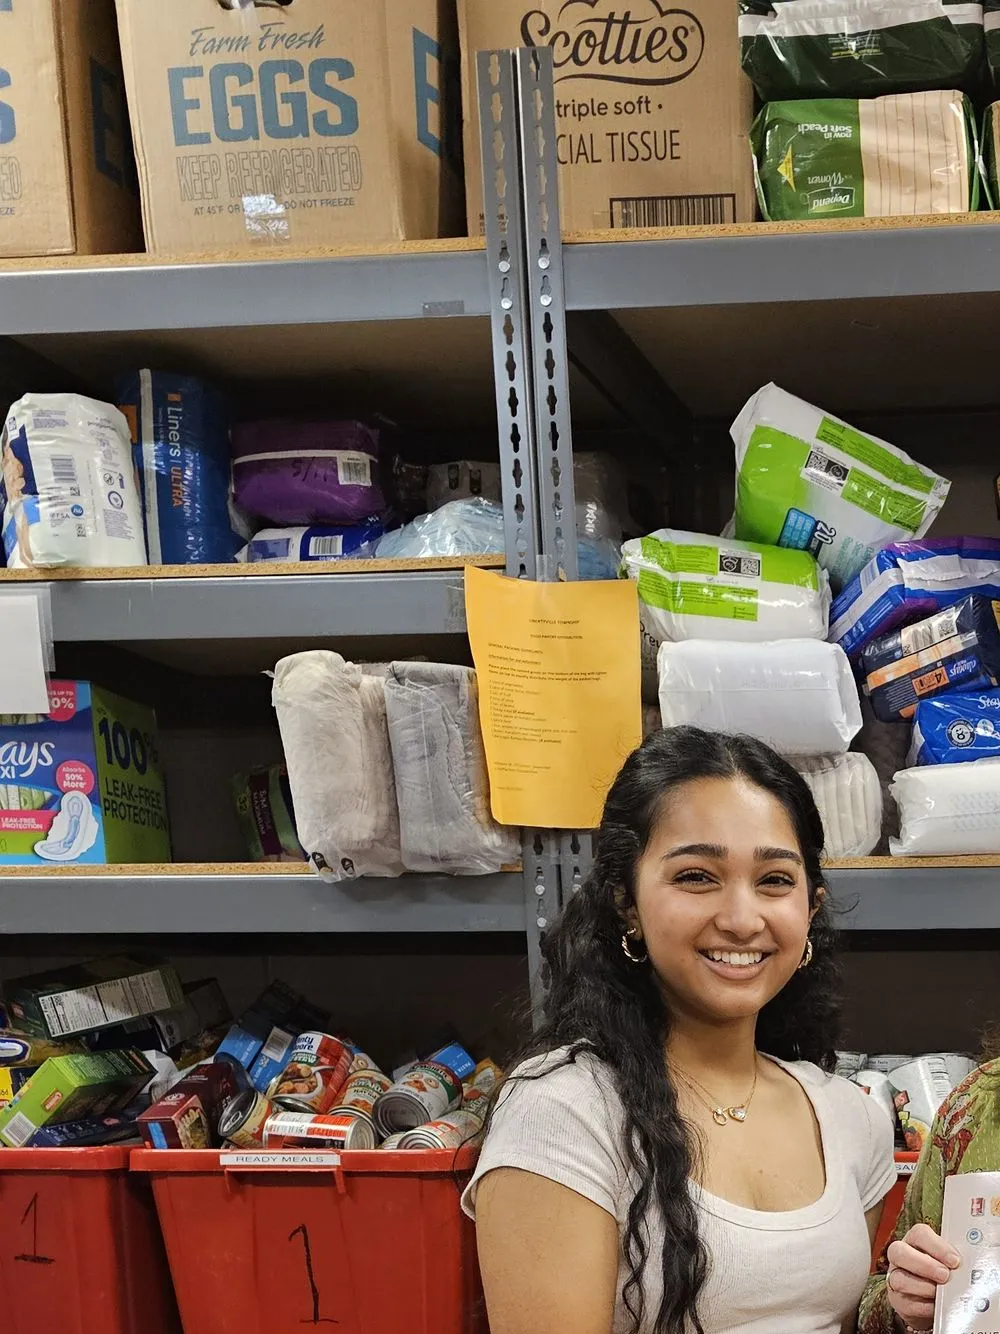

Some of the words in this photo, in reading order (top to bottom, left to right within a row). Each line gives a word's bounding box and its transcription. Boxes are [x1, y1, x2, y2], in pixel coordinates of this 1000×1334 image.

[190, 27, 250, 56] Farm
[258, 21, 325, 51] Fresh
[521, 10, 690, 69] Scotties
[167, 58, 359, 147] EGGS
[556, 99, 608, 122] triple
[613, 98, 652, 115] soft
[557, 133, 601, 165] CIAL
[606, 129, 681, 163] TISSUE
[175, 153, 222, 201] KEEP
[225, 145, 363, 197] REFRIGERATED
[285, 200, 297, 210] DO
[300, 198, 318, 209] NOT
[320, 196, 356, 208] FREEZE
[813, 194, 850, 210] Depend
[167, 407, 183, 457] Liners
[171, 466, 184, 507] ULTRA
[814, 519, 837, 545] 20
[51, 697, 74, 709] 0%
[0, 741, 55, 777] ays
[0, 766, 15, 779] XI
[105, 776, 162, 811] LEAK-FREE
[103, 798, 168, 832] PROTECTION
[235, 1155, 278, 1164] READY
[281, 1155, 325, 1165] MEALS
[14, 1192, 56, 1264] 1
[288, 1223, 340, 1325] 1
[960, 1296, 990, 1313] TO
